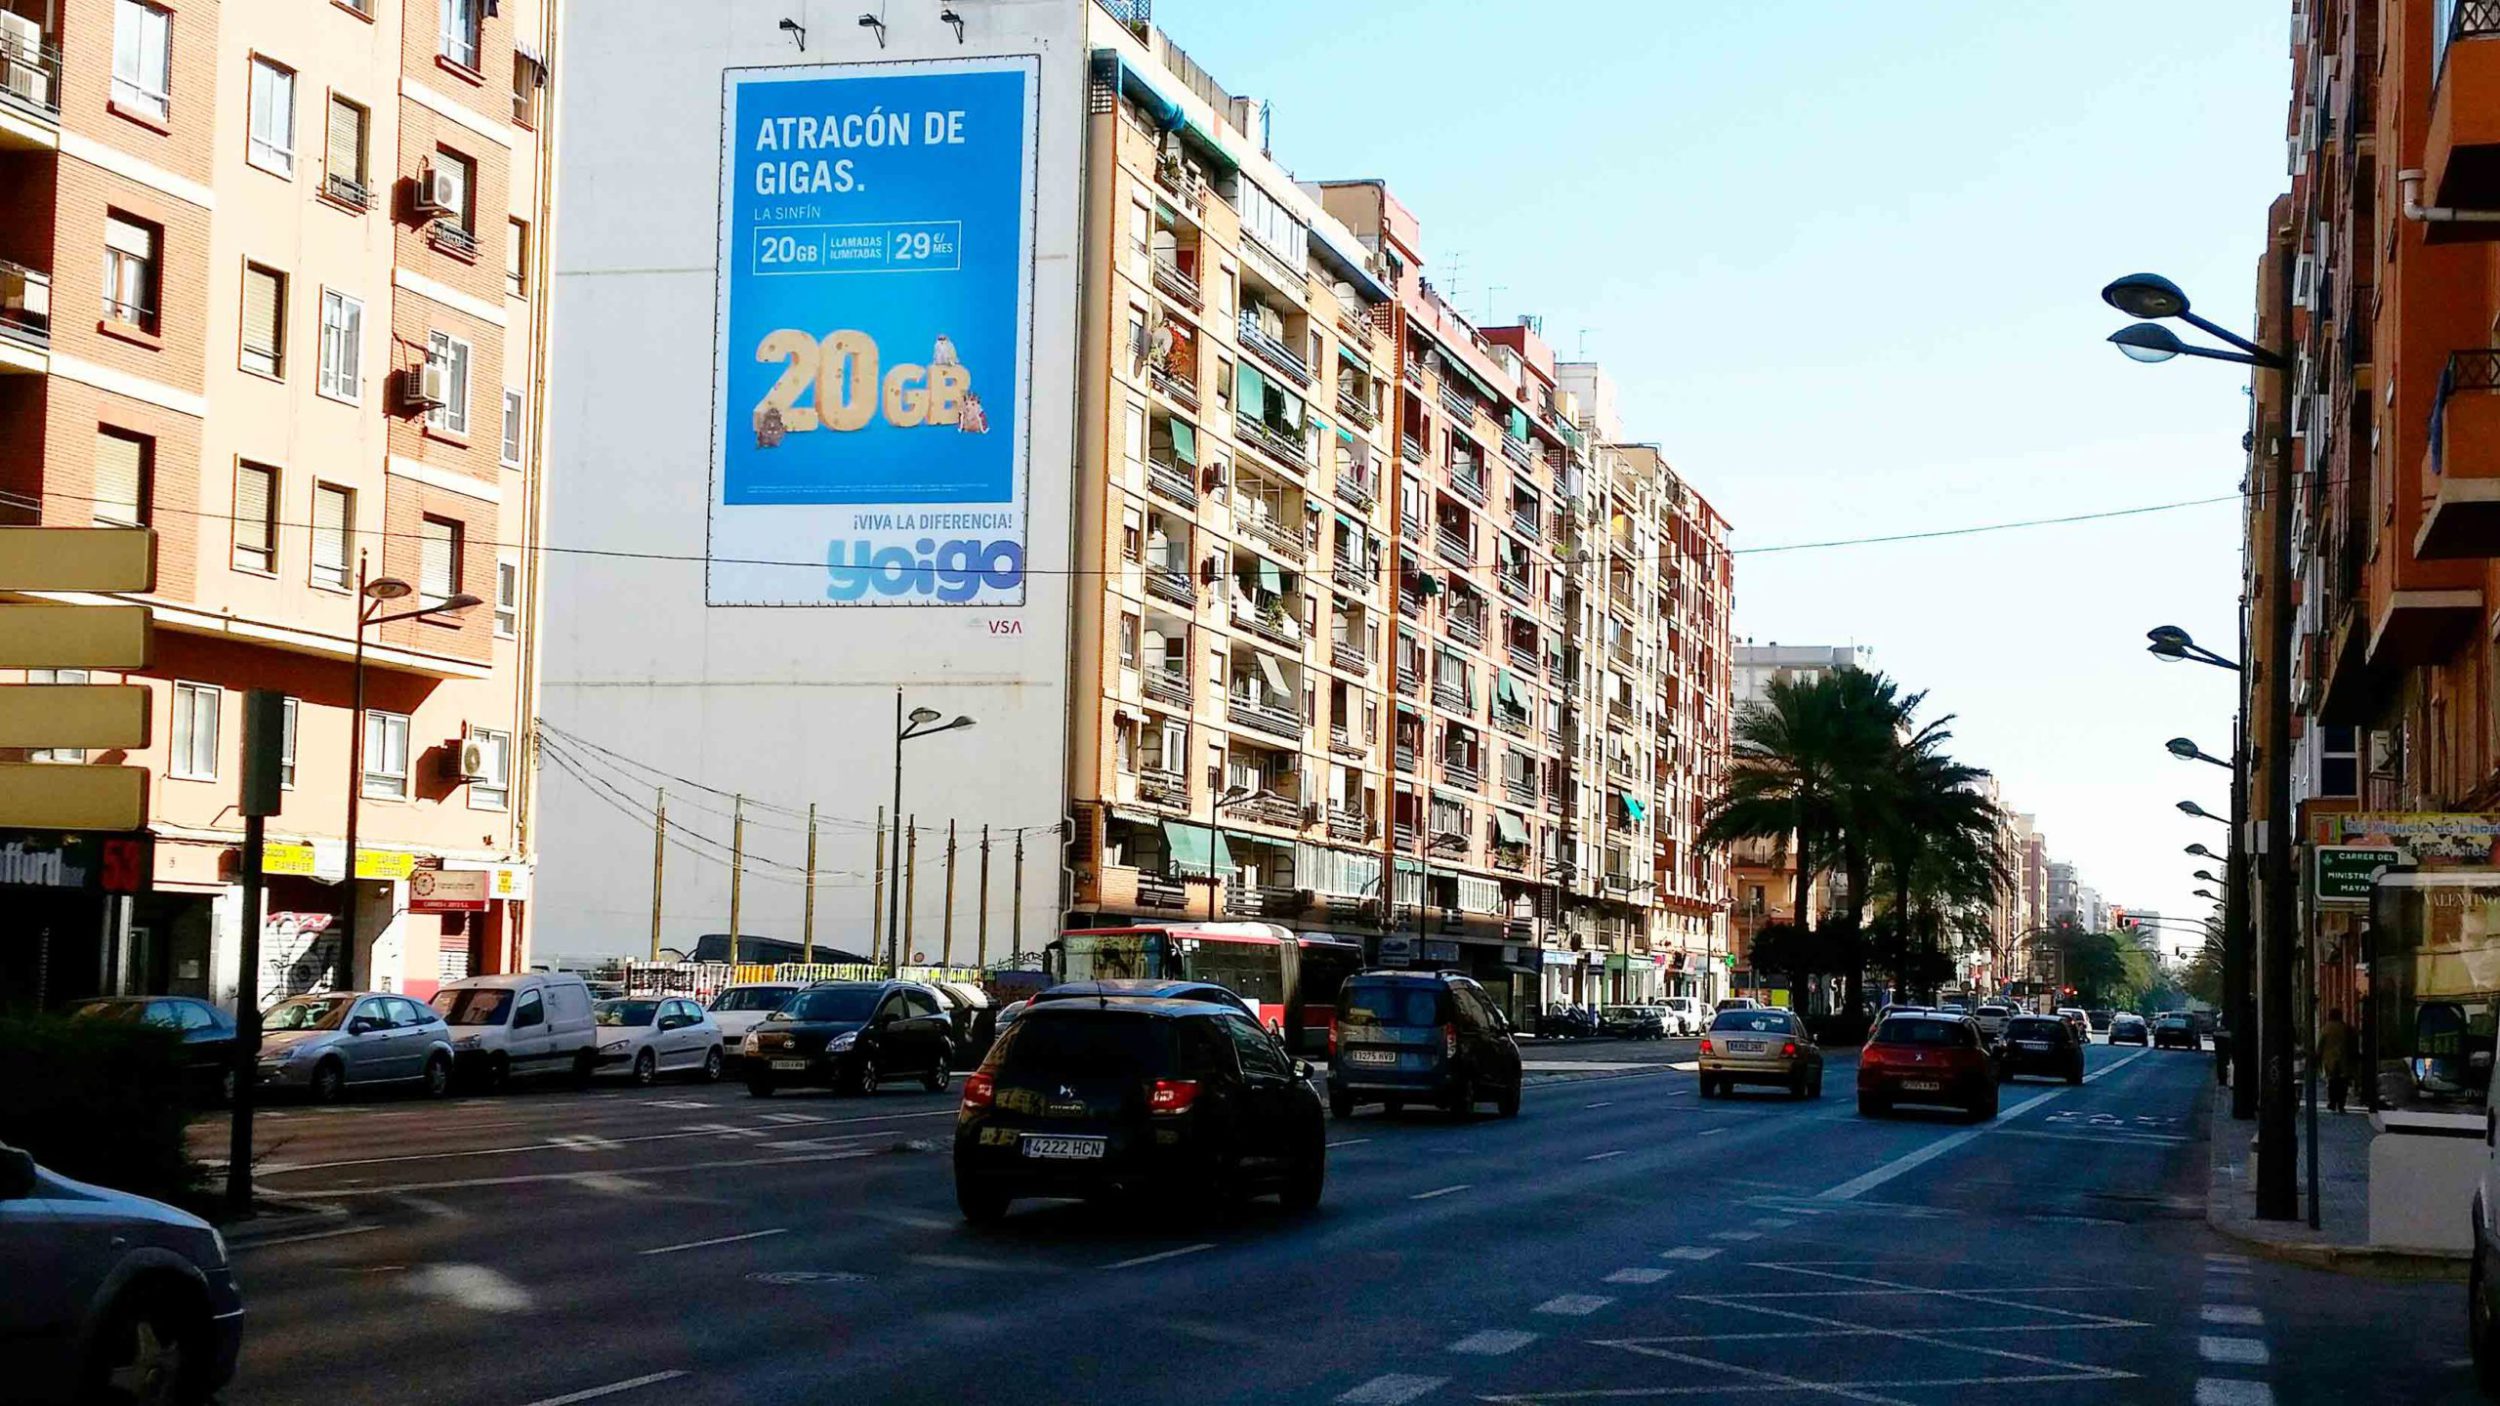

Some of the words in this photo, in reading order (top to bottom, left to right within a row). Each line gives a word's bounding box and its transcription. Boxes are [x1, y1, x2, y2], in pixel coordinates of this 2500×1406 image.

[755, 106, 911, 151] ATRACÓN
[924, 111, 966, 145] DE
[756, 159, 865, 195] GIGAS.
[754, 208, 771, 220] LA
[775, 204, 821, 220] SINFÍN
[761, 236, 818, 263] 20GB
[895, 232, 931, 259] 29
[830, 236, 882, 248] LLAMADAS
[932, 242, 953, 253] MES
[830, 248, 882, 260] ILIMITADAS
[853, 514, 892, 530] ¡VIVA
[896, 514, 915, 530] LA
[919, 513, 1012, 530] DIFERENCIA!
[826, 538, 1024, 603] yoigo
[988, 620, 1022, 634] VSA
[2338, 852, 2375, 861] CARRER
[2377, 853, 2394, 862] DEL
[2327, 871, 2371, 880] MINISTRE
[1033, 1140, 1069, 1154] 4222
[1072, 1141, 1100, 1156] HCN
